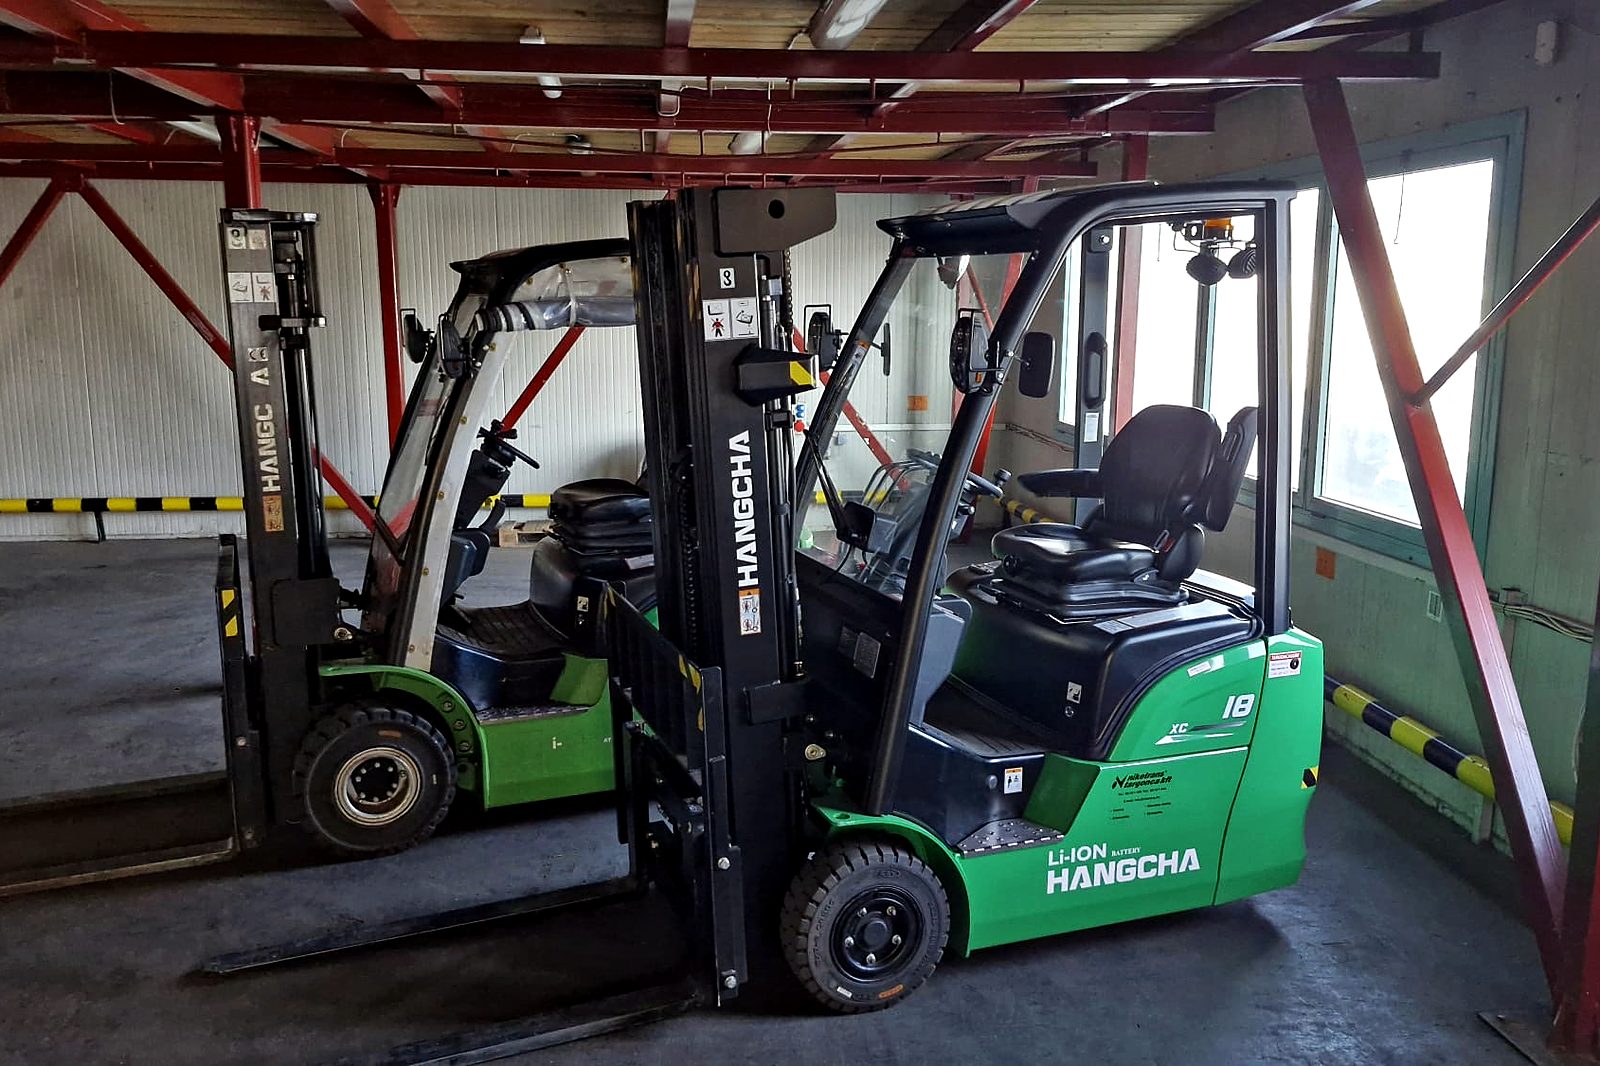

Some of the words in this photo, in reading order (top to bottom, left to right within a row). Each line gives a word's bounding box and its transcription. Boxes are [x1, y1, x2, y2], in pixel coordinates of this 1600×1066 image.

[729, 429, 759, 588] HANGCHA
[1221, 693, 1255, 719] 18
[1169, 722, 1189, 735] XC
[1048, 842, 1107, 866] Li-ION
[1111, 846, 1142, 857] BATTERY
[1047, 847, 1201, 895] HANGCHA
